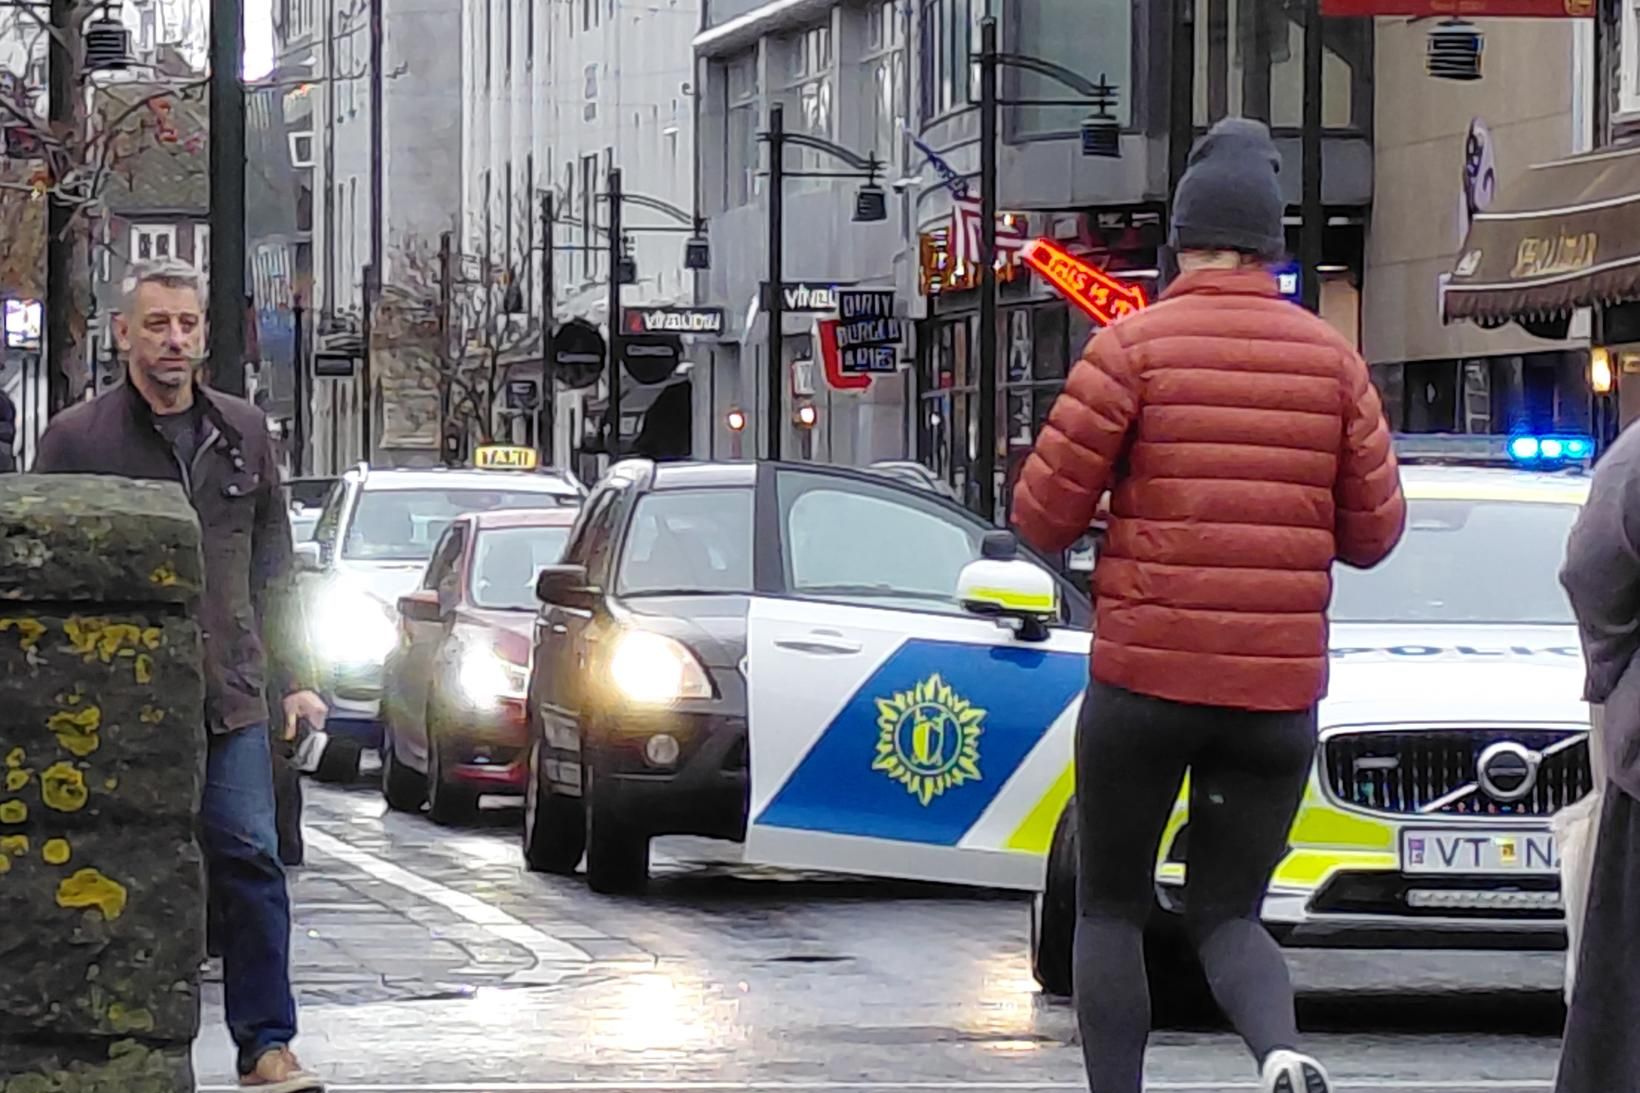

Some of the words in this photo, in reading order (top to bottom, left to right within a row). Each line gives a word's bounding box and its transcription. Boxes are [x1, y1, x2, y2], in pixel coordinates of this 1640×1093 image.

[843, 293, 891, 318] DIRTY
[480, 449, 531, 466] TAXI
[1435, 838, 1491, 867] VT
